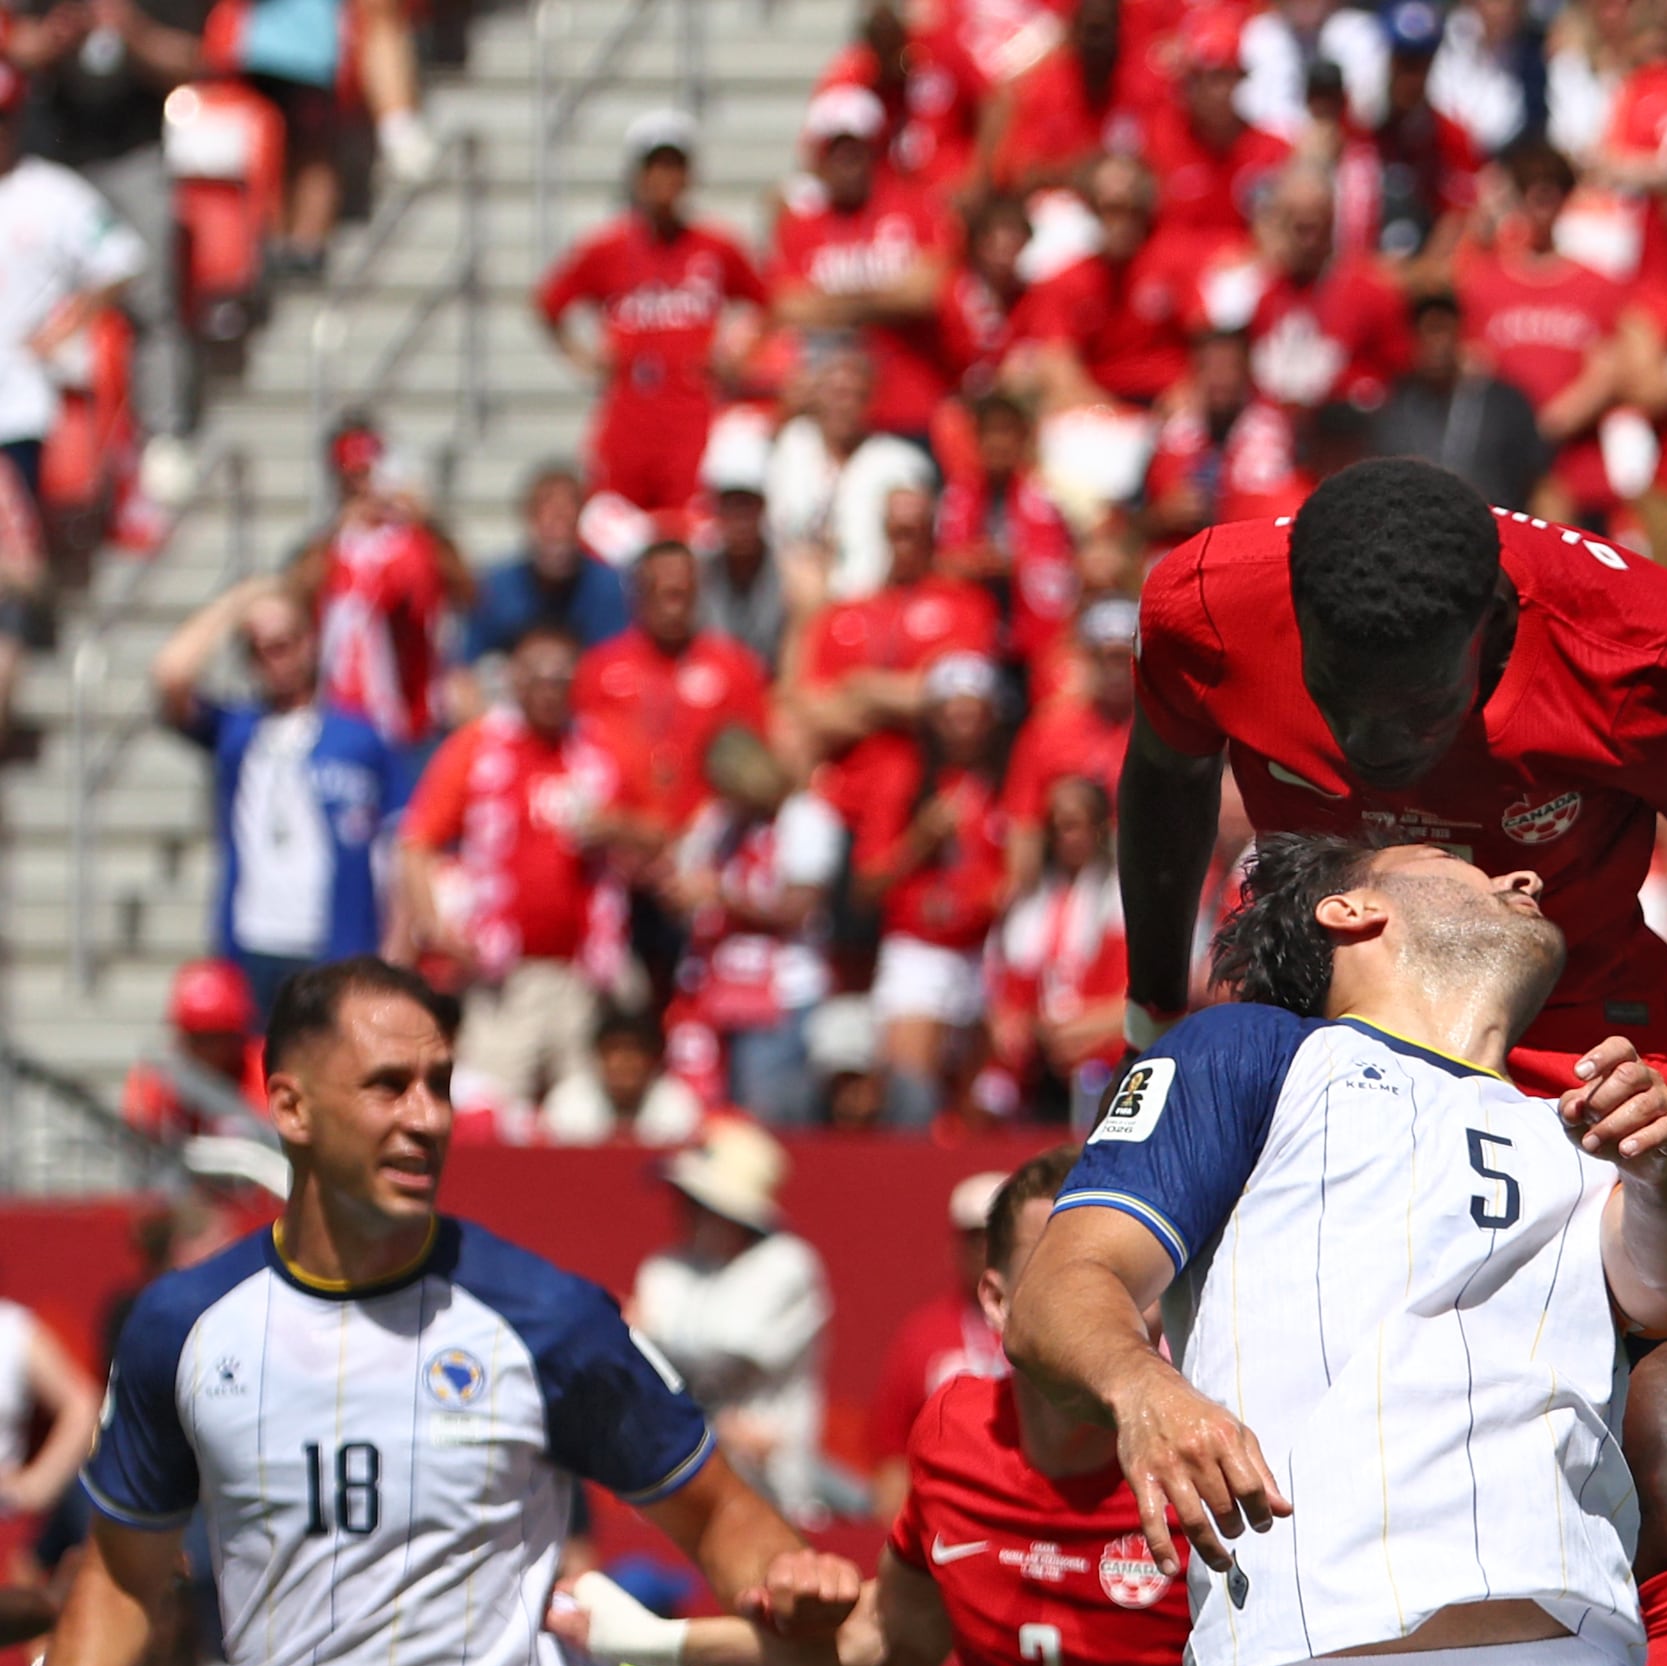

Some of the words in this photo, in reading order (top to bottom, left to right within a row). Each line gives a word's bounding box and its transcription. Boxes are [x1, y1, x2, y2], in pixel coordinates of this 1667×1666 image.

[1504, 793, 1578, 828] CANADA
[1346, 1079, 1400, 1096] KELME
[1465, 1127, 1522, 1229] 5
[303, 1442, 382, 1536] 18
[1100, 1561, 1162, 1576] CANAD
